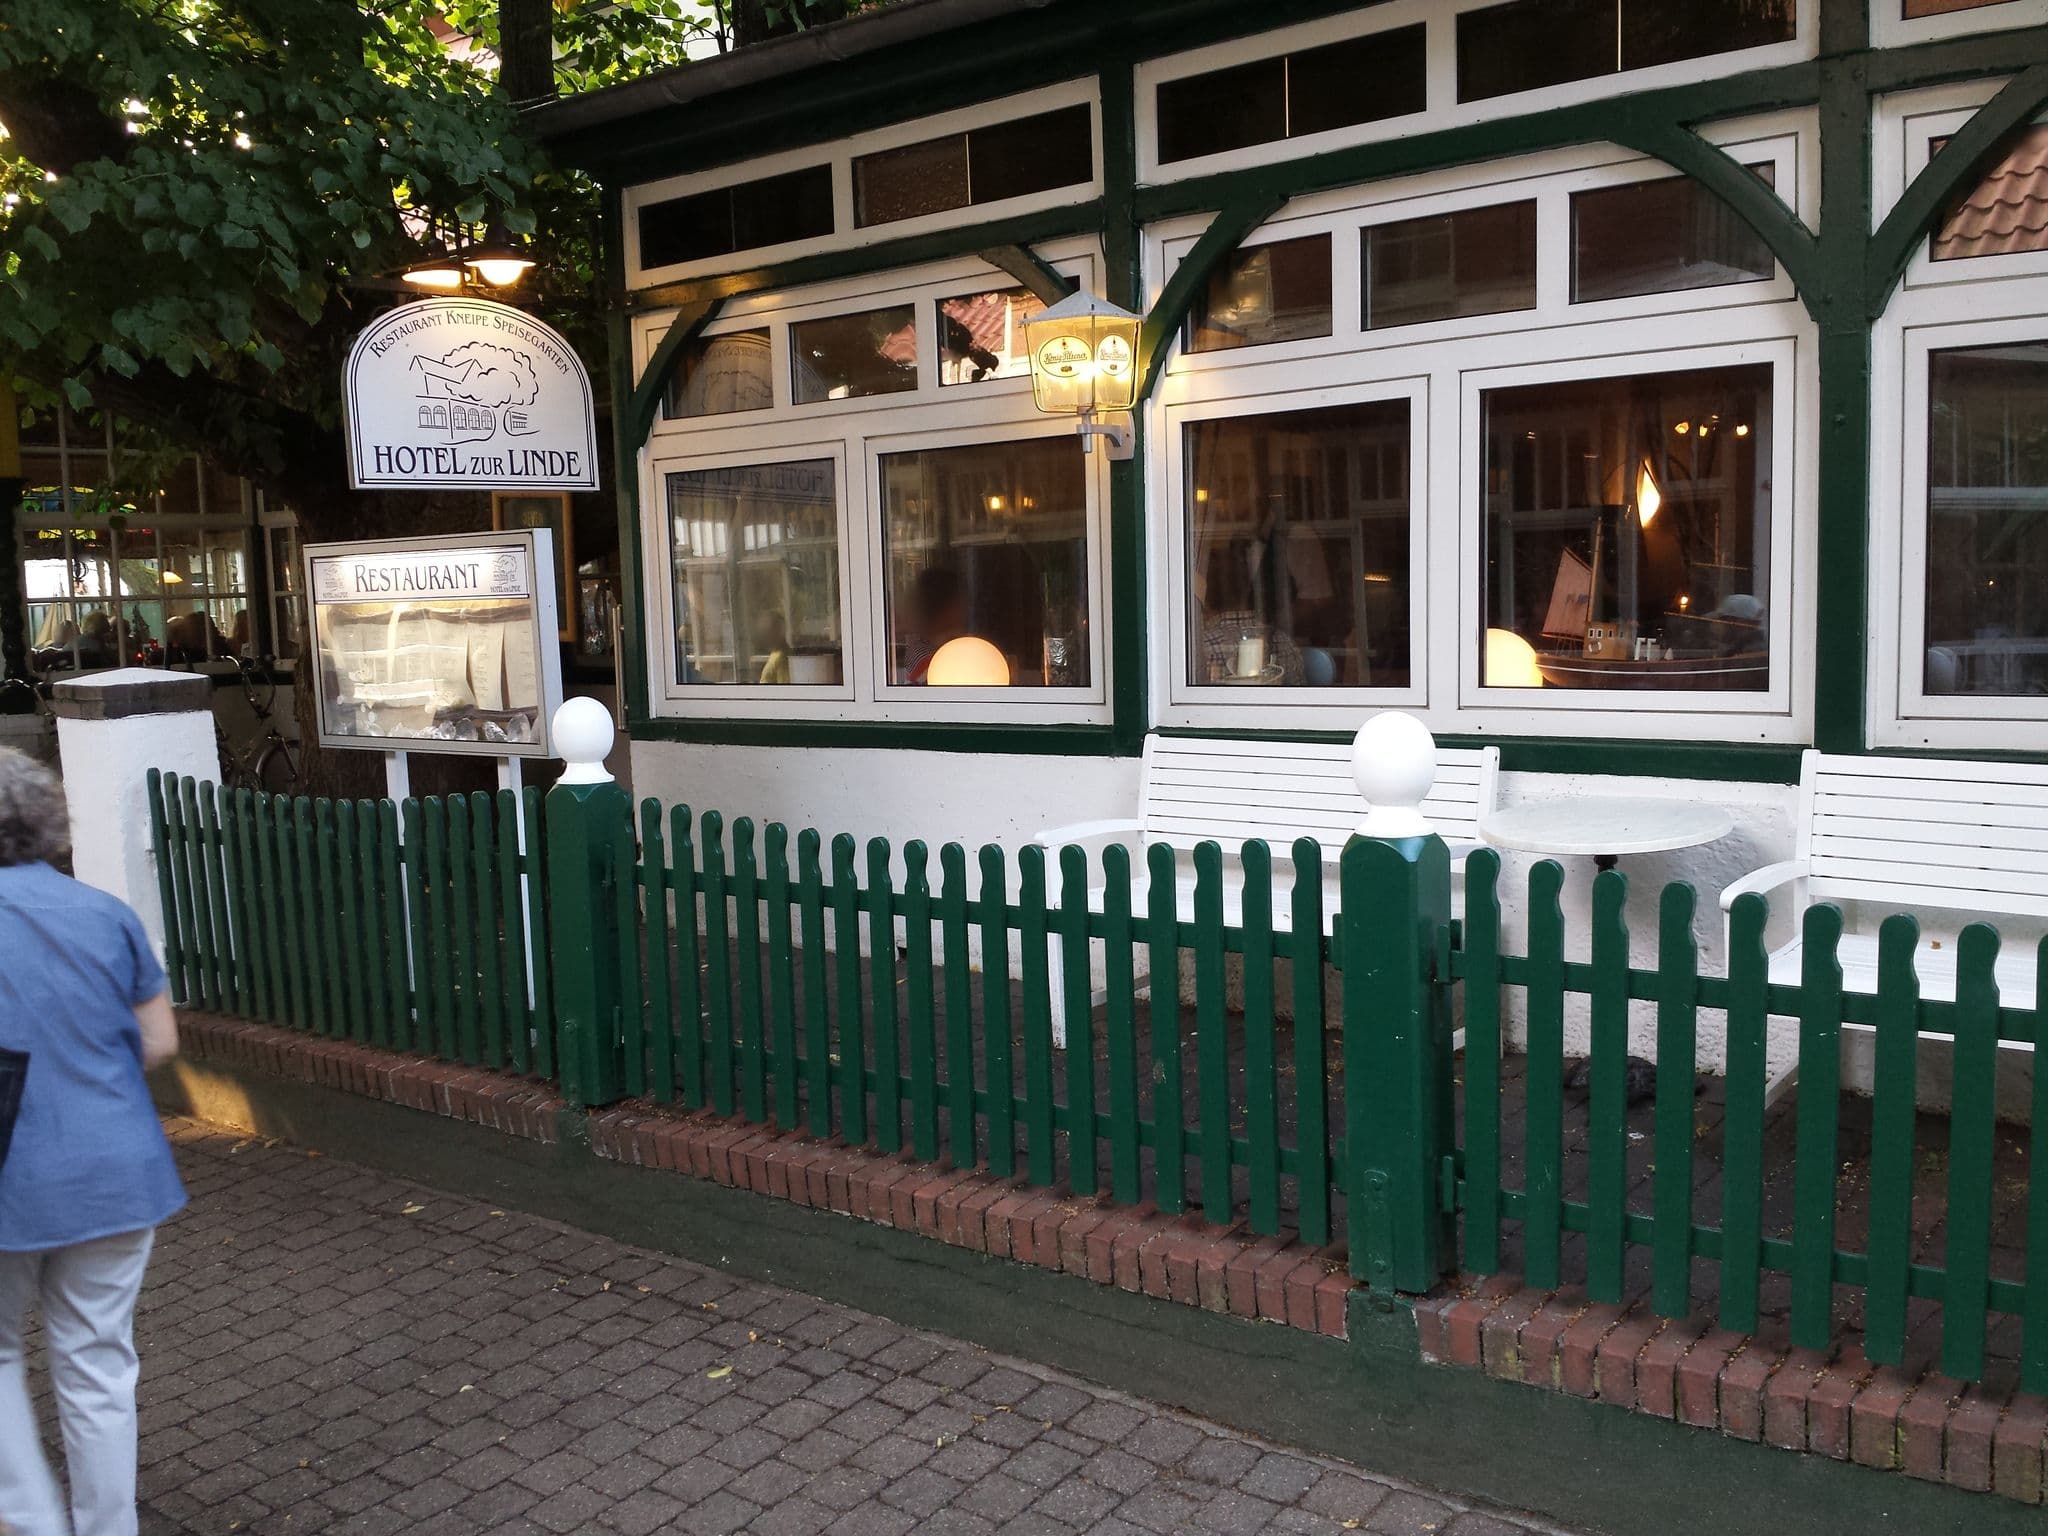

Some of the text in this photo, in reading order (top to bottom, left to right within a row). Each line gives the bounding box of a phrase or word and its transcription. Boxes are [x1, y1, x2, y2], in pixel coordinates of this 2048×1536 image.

[370, 310, 570, 375] RESTAURANT KNEIPE SPEISEGARTEN
[373, 445, 582, 477] HOTEL ZUR LINDE
[354, 563, 480, 593] RESTAURANT
